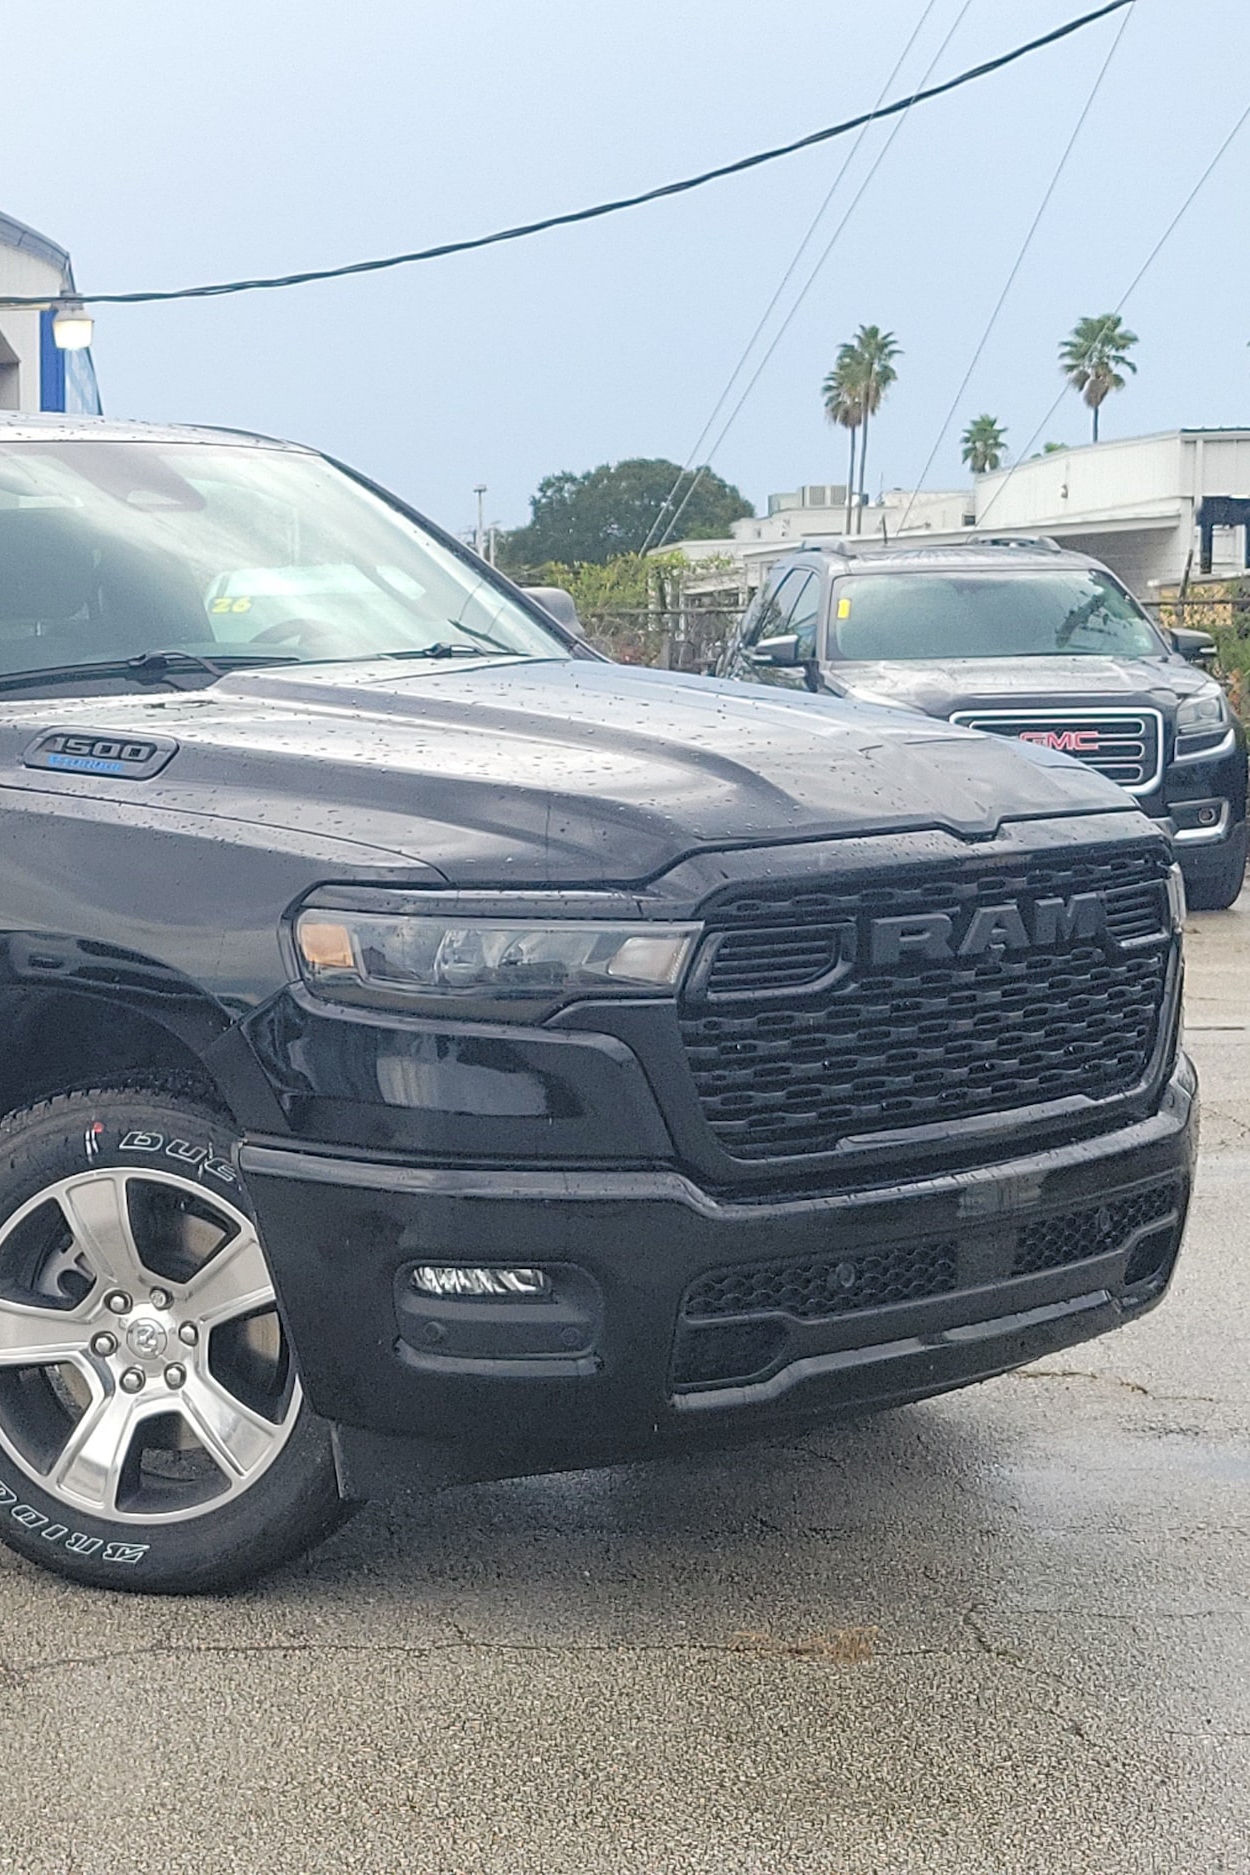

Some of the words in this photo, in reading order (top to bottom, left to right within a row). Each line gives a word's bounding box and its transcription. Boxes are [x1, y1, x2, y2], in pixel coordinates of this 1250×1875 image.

[211, 596, 252, 613] 26
[51, 737, 151, 761] 1500
[1019, 730, 1099, 750] GMC
[871, 892, 1105, 966] RAM
